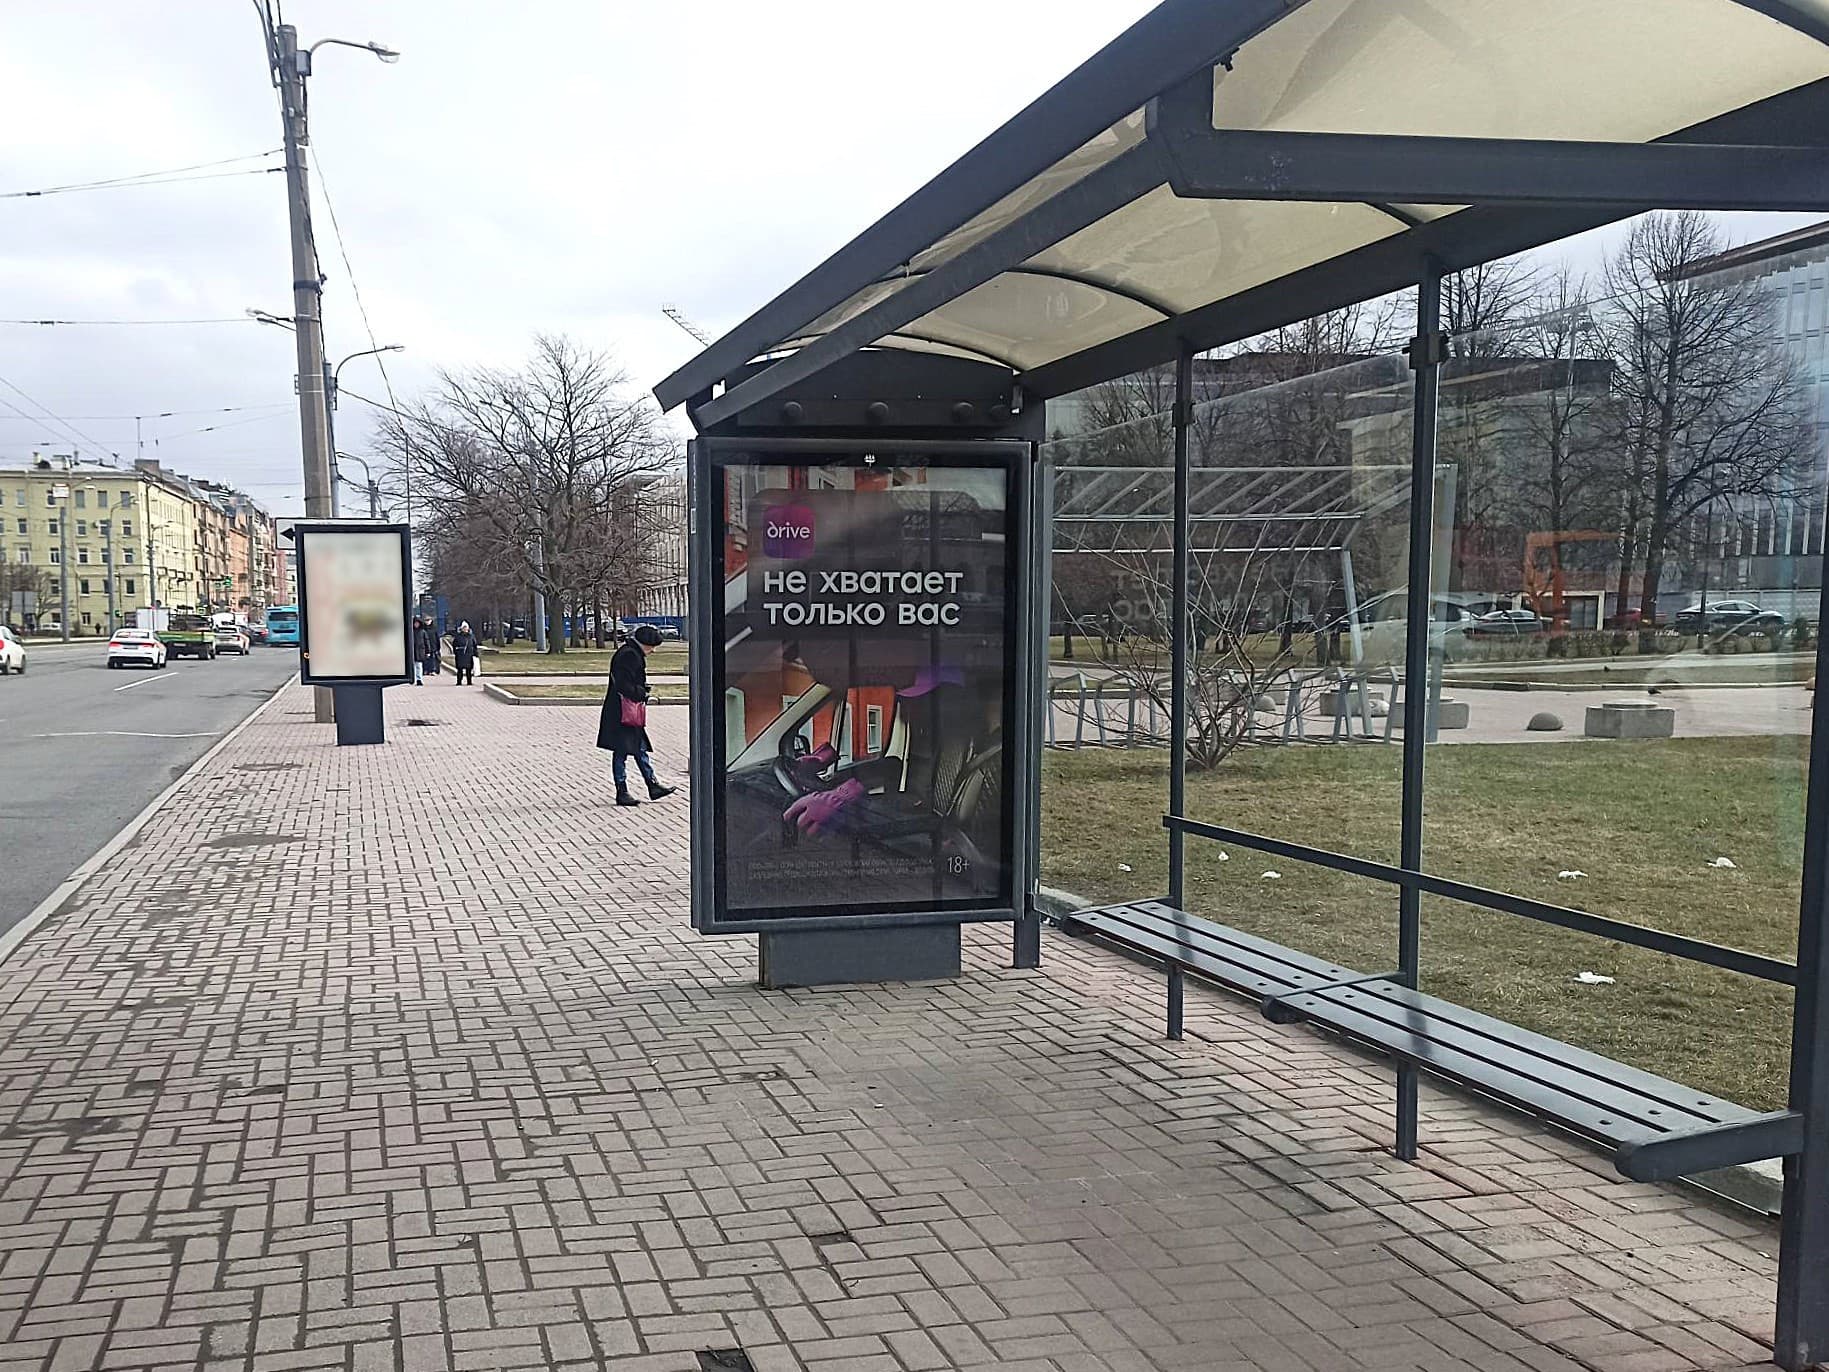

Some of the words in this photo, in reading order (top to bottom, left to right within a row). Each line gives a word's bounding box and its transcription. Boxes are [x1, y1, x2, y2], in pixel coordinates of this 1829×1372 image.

[766, 521, 811, 540] drive
[764, 570, 807, 594] не
[819, 570, 963, 594] хватает
[763, 602, 886, 626] только
[898, 602, 961, 625] вас
[947, 856, 970, 874] 18+
